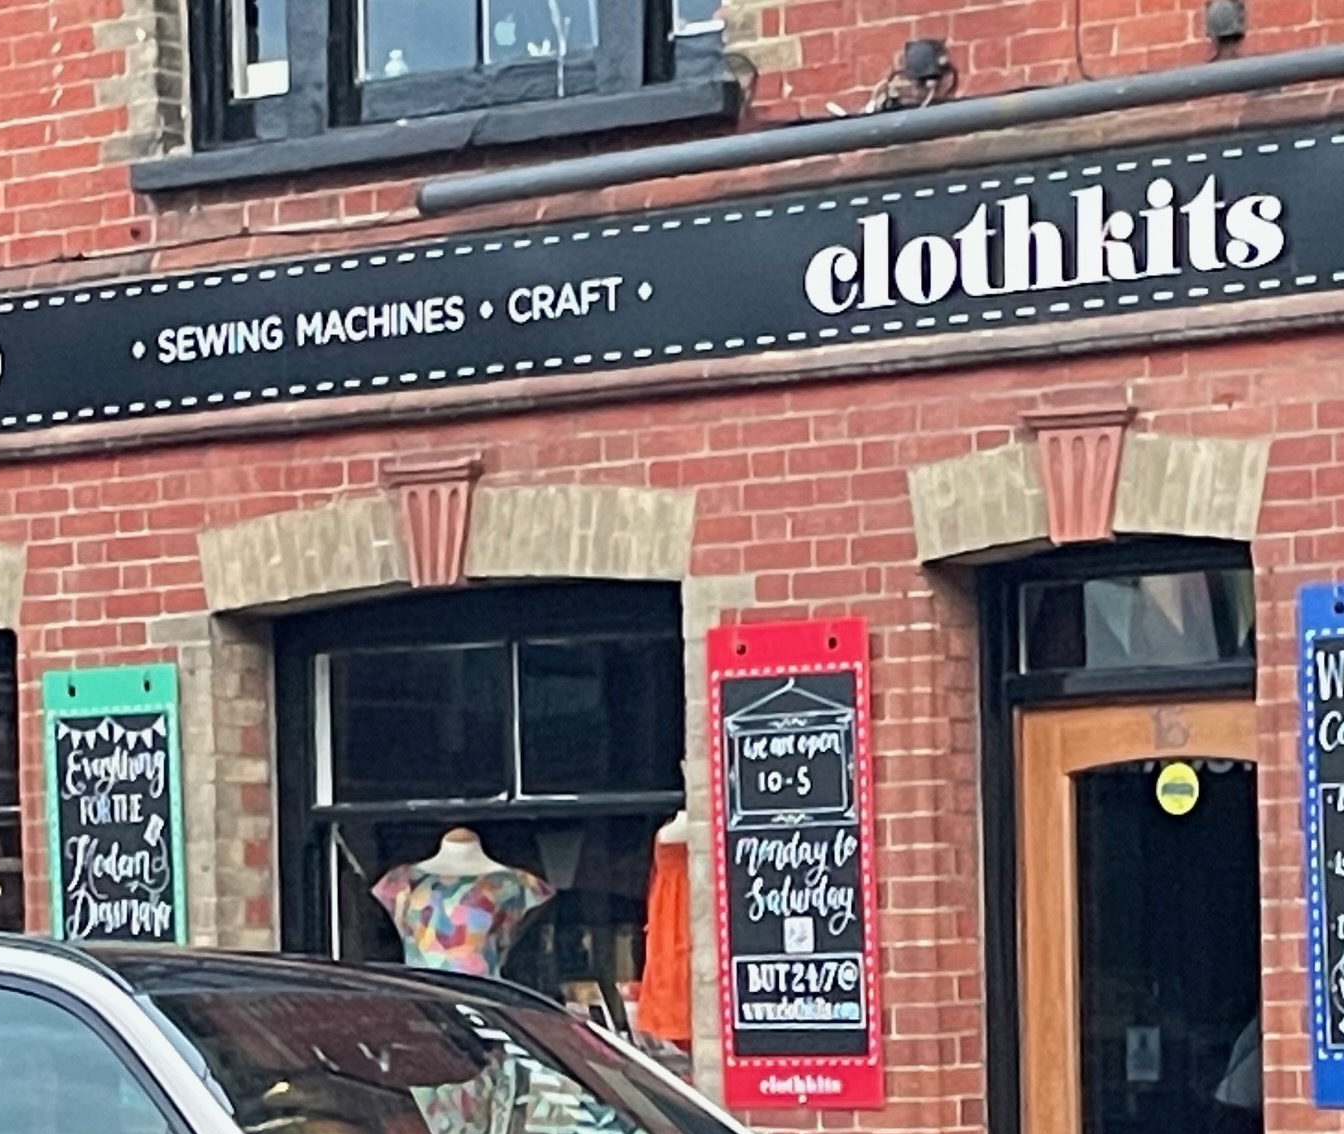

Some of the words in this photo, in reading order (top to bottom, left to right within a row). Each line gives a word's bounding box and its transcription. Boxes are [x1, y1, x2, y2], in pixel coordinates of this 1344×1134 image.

[803, 173, 1287, 316] clothkits
[157, 315, 284, 364] SEWING
[296, 296, 466, 347] MACHINES
[507, 276, 623, 324] CRAFT
[745, 875, 856, 936] Saturday
[759, 1074, 842, 1095] clothkits
